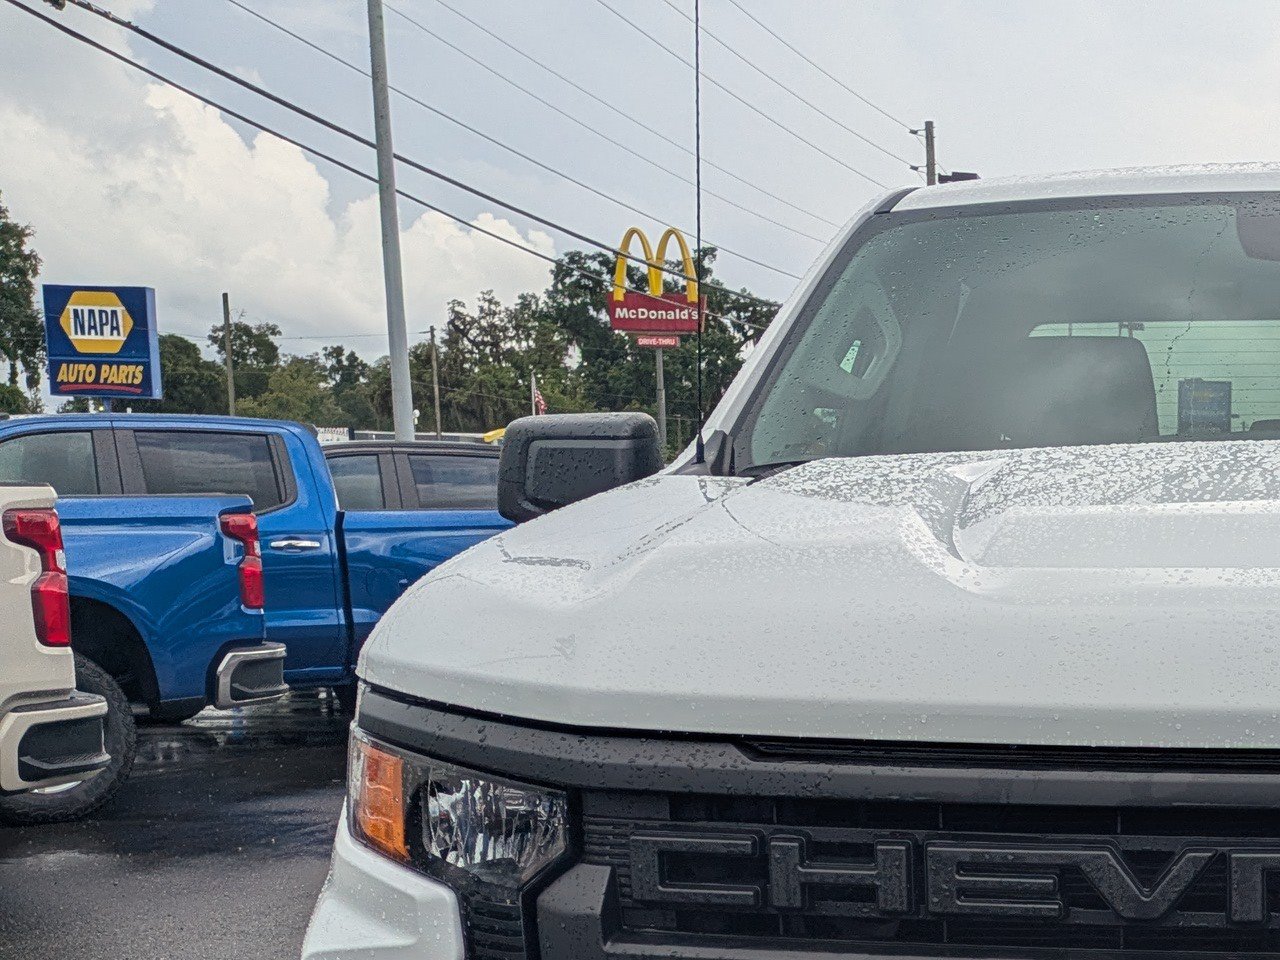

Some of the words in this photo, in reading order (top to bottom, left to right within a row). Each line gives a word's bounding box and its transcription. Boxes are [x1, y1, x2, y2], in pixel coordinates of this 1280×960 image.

[72, 308, 121, 336] NAPA
[615, 307, 699, 320] McDonald's
[637, 337, 676, 346] DRIVE-THRU
[57, 363, 97, 383] AUTO
[100, 364, 144, 385] PARTS
